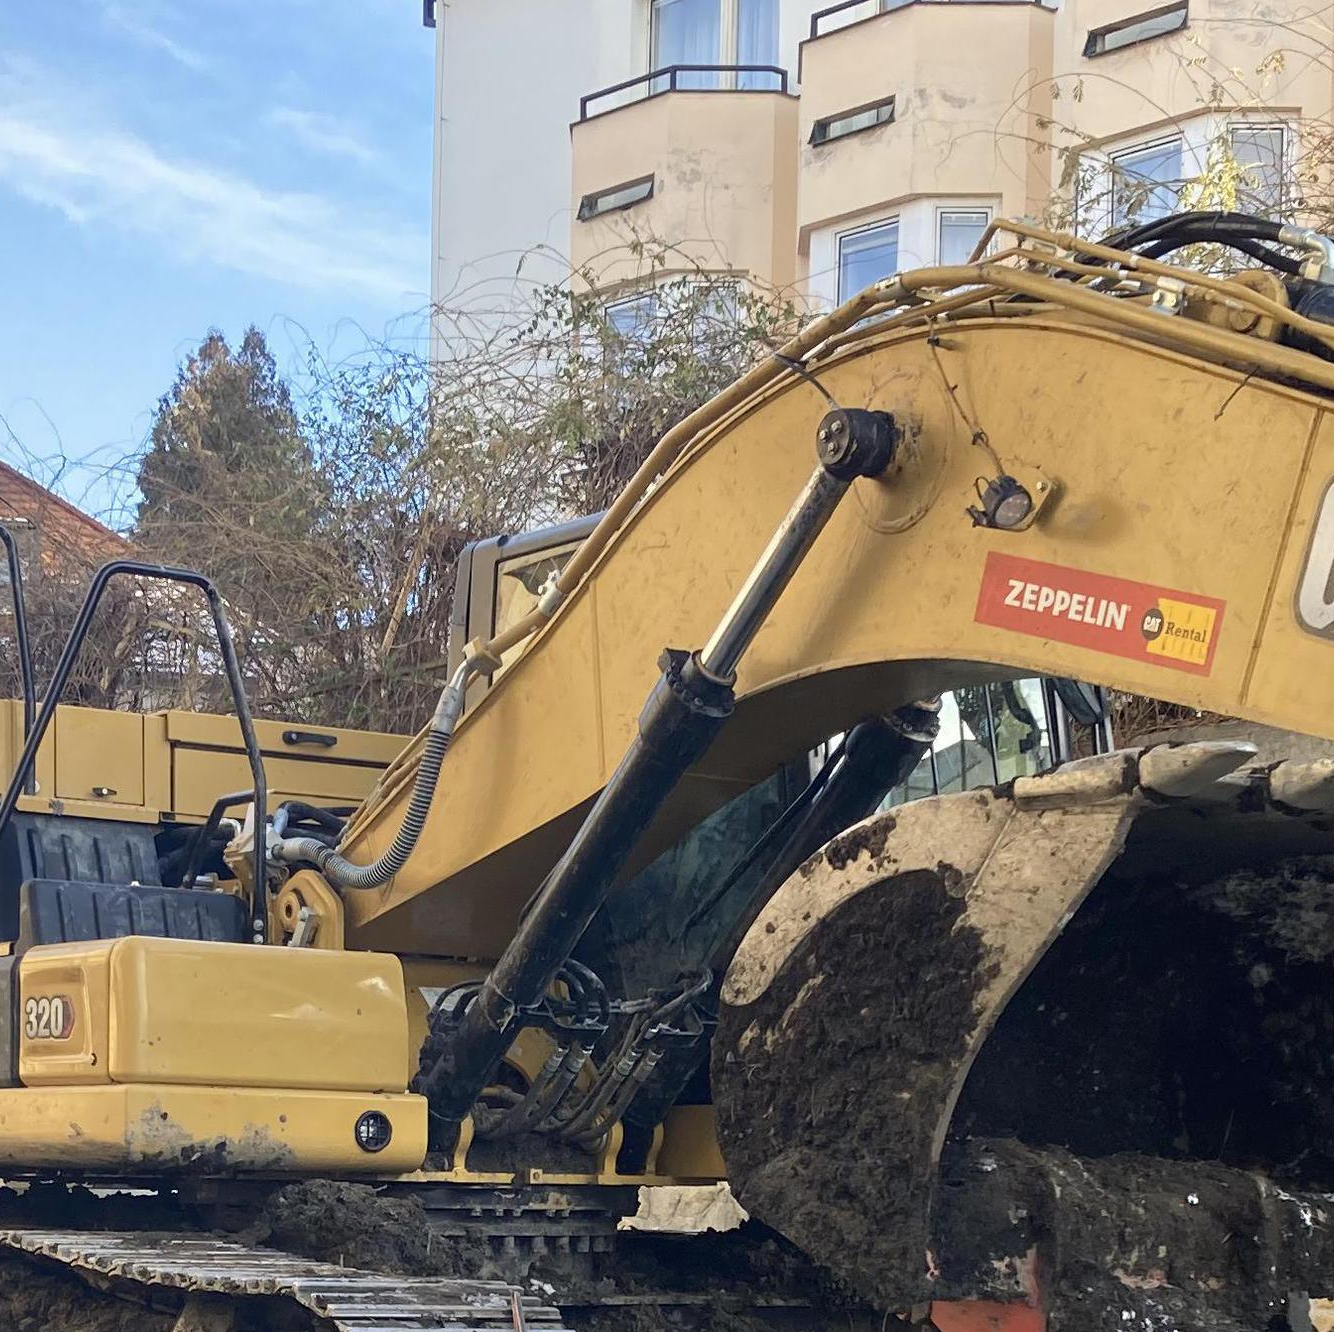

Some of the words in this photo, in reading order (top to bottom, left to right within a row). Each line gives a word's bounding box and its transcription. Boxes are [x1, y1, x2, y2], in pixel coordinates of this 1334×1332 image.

[1004, 579, 1130, 632] ZEPPELIN
[1143, 615, 1162, 634] CAT
[1165, 621, 1208, 644] Rental
[25, 996, 64, 1039] 320
